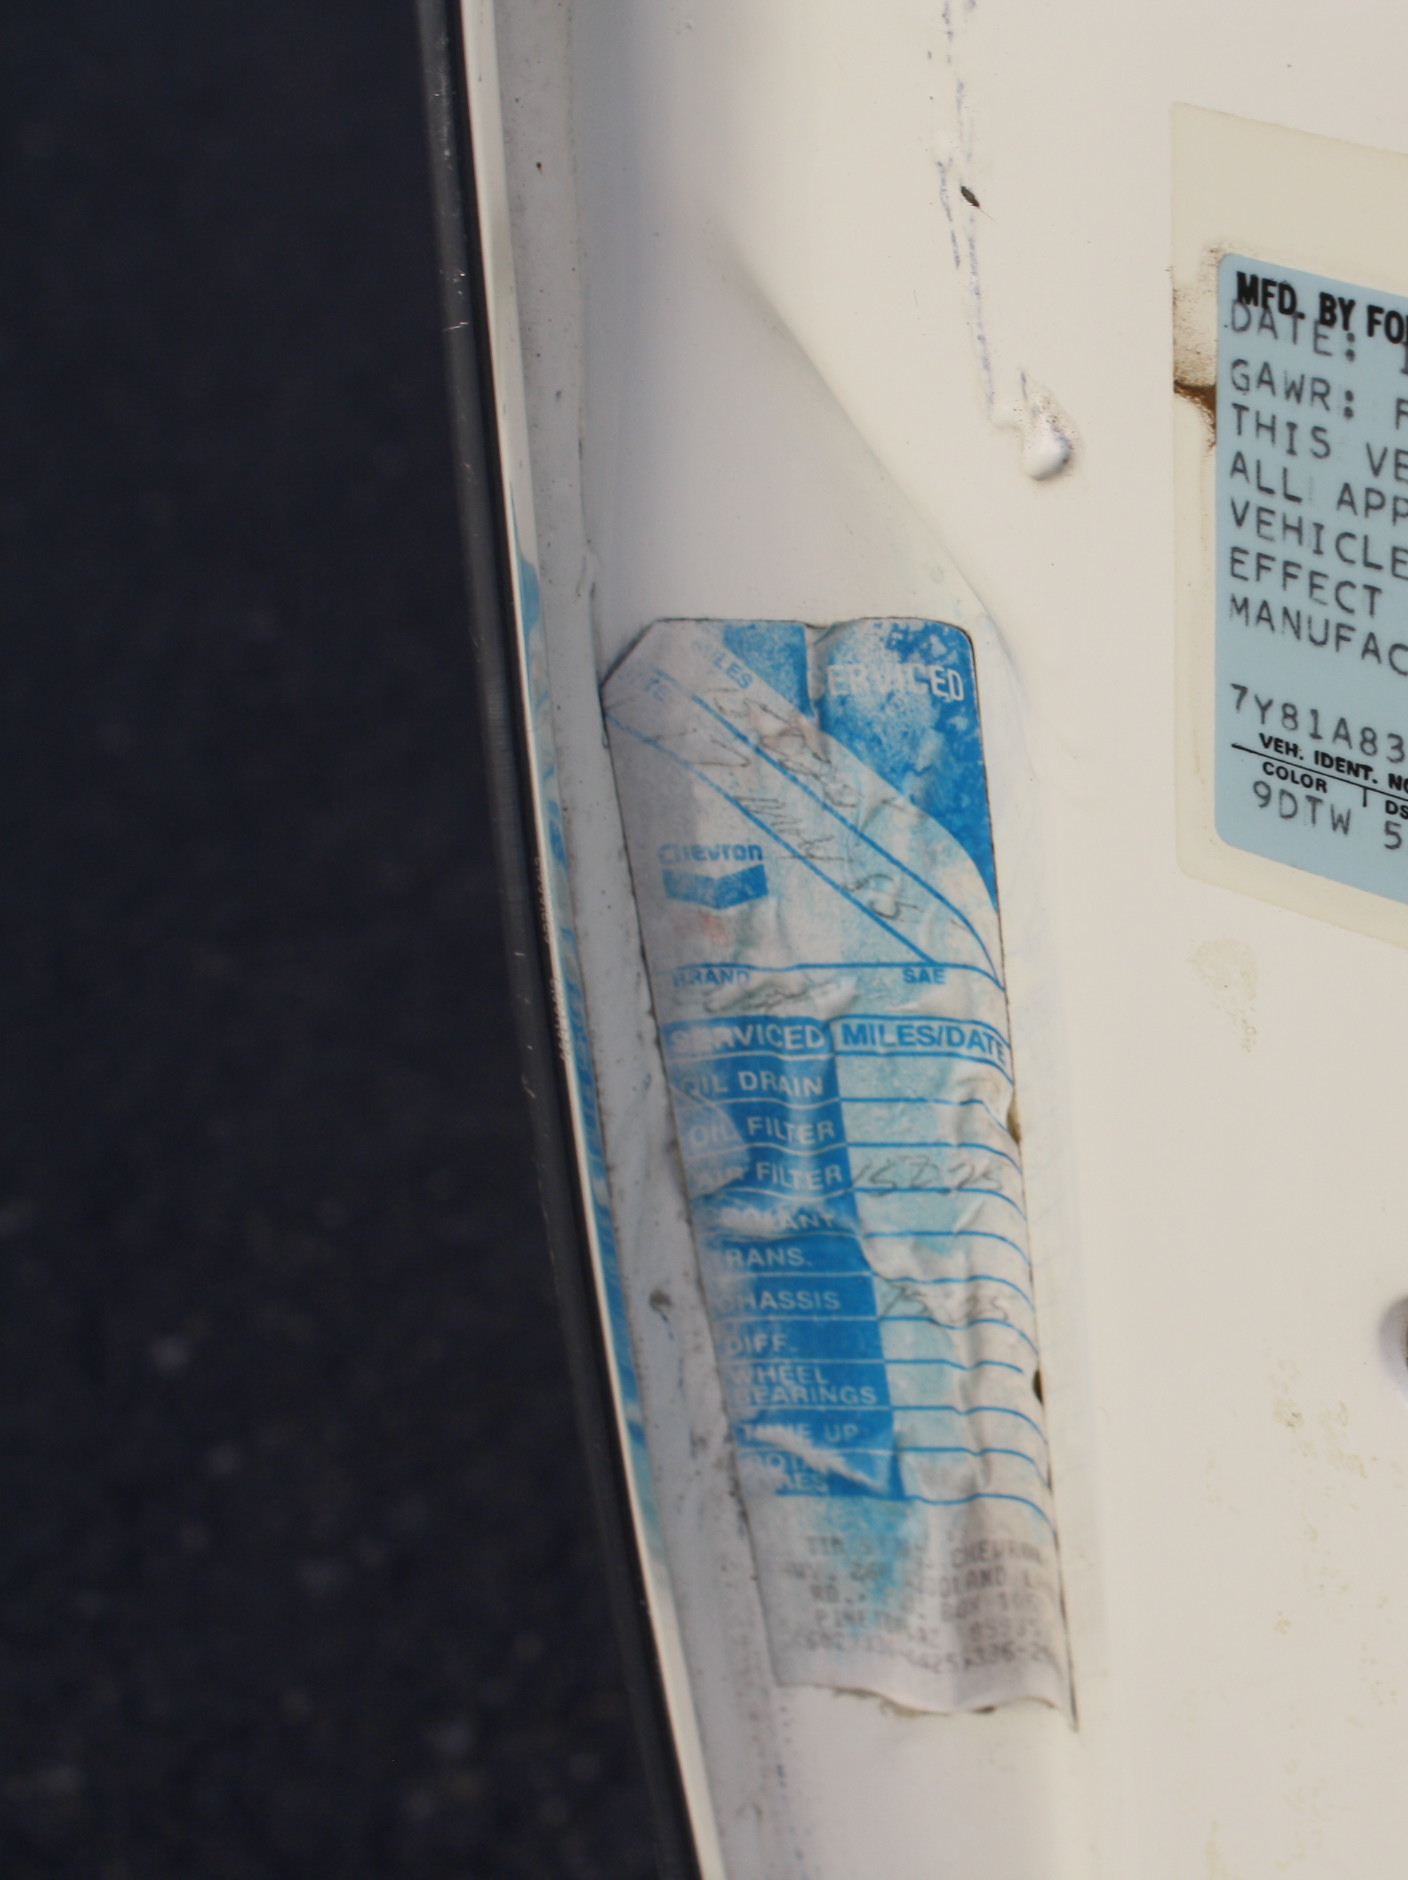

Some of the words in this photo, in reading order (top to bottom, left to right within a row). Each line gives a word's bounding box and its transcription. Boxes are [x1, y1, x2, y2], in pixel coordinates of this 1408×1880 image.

[1236, 270, 1306, 319] MFD.
[1319, 291, 1356, 332] BY
[1230, 301, 1356, 363] DATE:
[1230, 358, 1354, 420] GAWR:
[1231, 403, 1331, 459] THIS
[1230, 451, 1303, 502] ALL
[1229, 546, 1383, 618] EFFECT
[1259, 733, 1304, 761] VEH.
[1314, 750, 1378, 784] IDENT.
[1262, 761, 1327, 793] COLOR
[902, 968, 946, 984] SAE
[841, 1023, 1006, 1065] MILES/DATE
[738, 1070, 823, 1096] DRAIN
[747, 1116, 835, 1144] FILTER
[756, 1162, 842, 1191] FILTER
[713, 1248, 815, 1268] RANS.
[824, 1423, 859, 1442] UP
